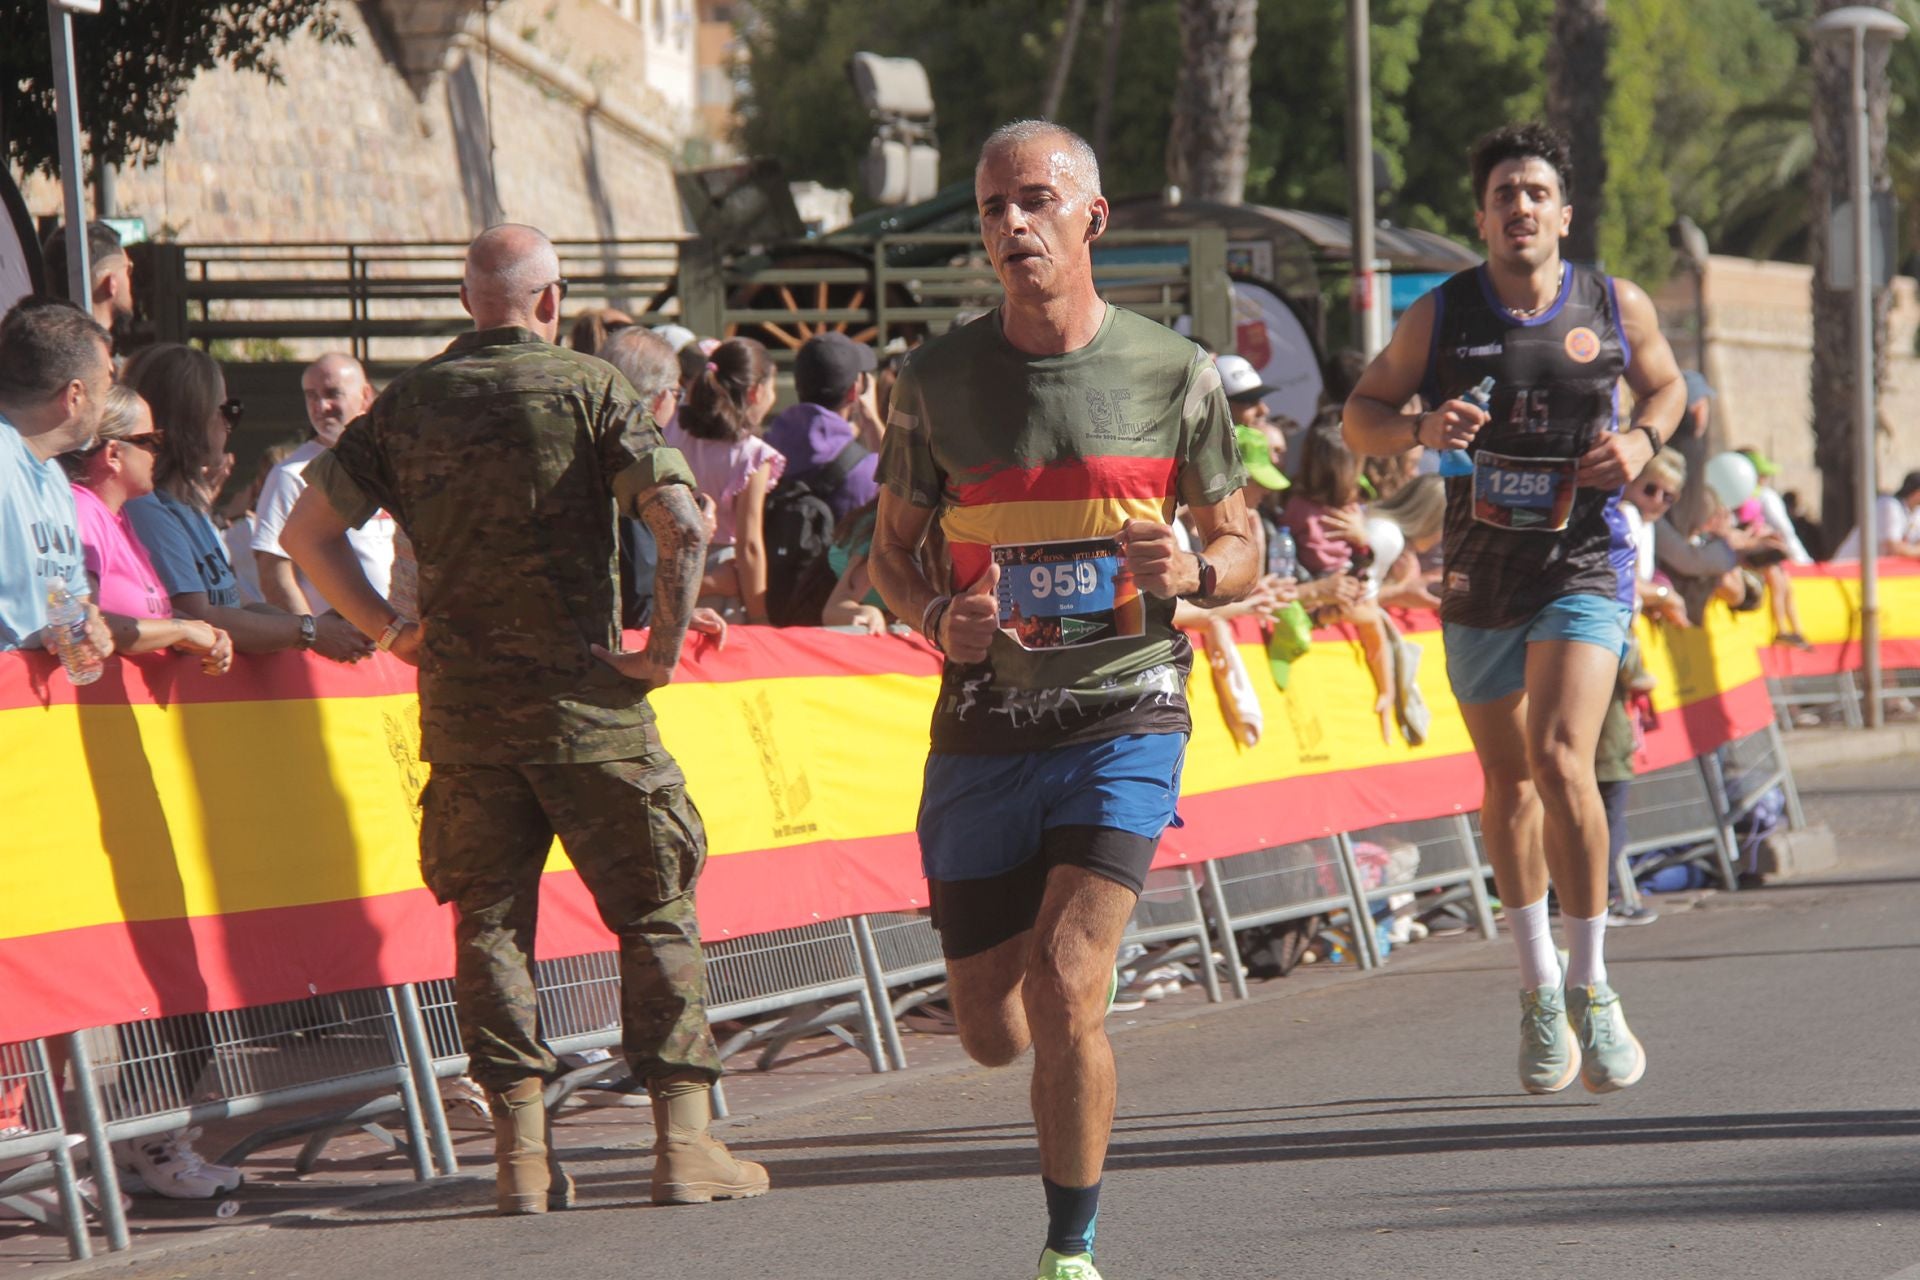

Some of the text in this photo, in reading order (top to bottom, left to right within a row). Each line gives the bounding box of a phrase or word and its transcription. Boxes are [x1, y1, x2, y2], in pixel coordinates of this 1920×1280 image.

[1510, 389, 1549, 433] 45
[1488, 471, 1550, 495] 1258
[1030, 562, 1098, 599] 959
